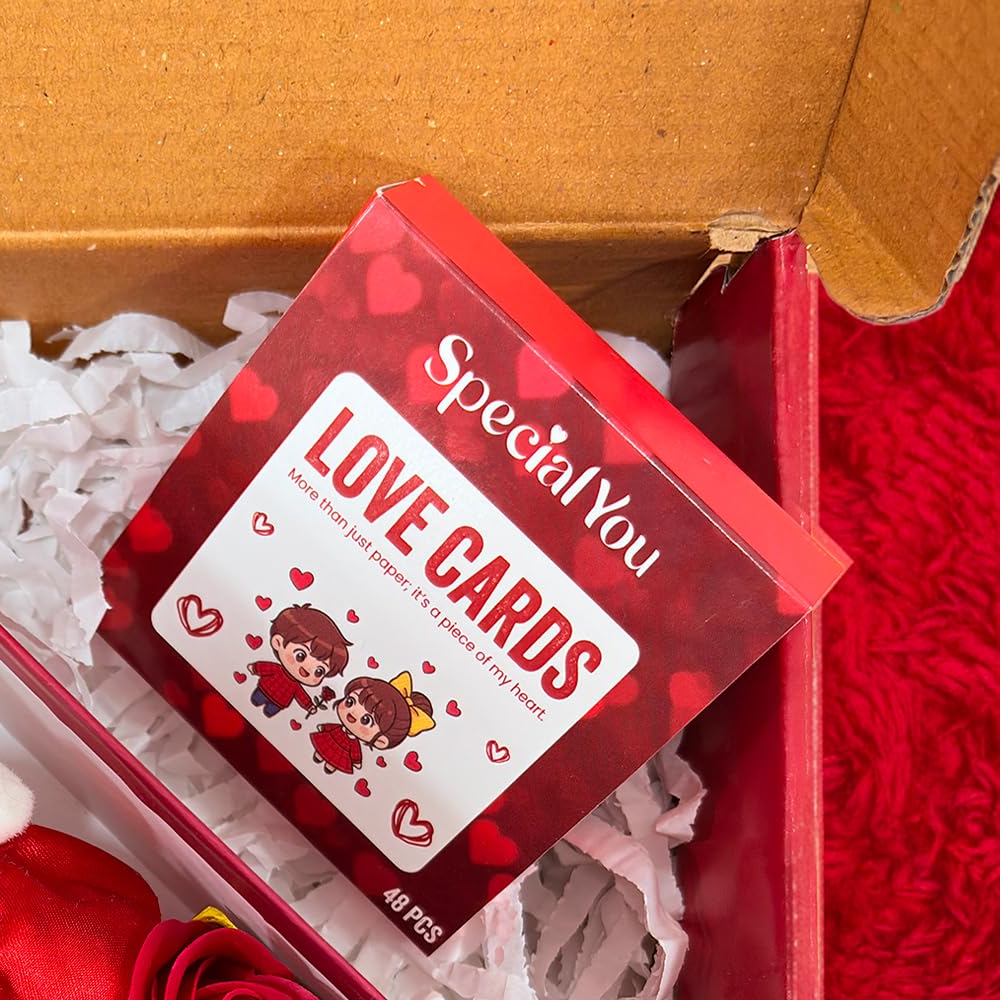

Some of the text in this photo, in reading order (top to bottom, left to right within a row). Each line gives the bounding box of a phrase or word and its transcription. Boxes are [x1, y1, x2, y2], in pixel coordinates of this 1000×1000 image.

[287, 467, 547, 722] More than just paper; it's a piece of my heart.
[303, 406, 603, 701] LOVE CARDS
[382, 887, 443, 944] 48 PCS
